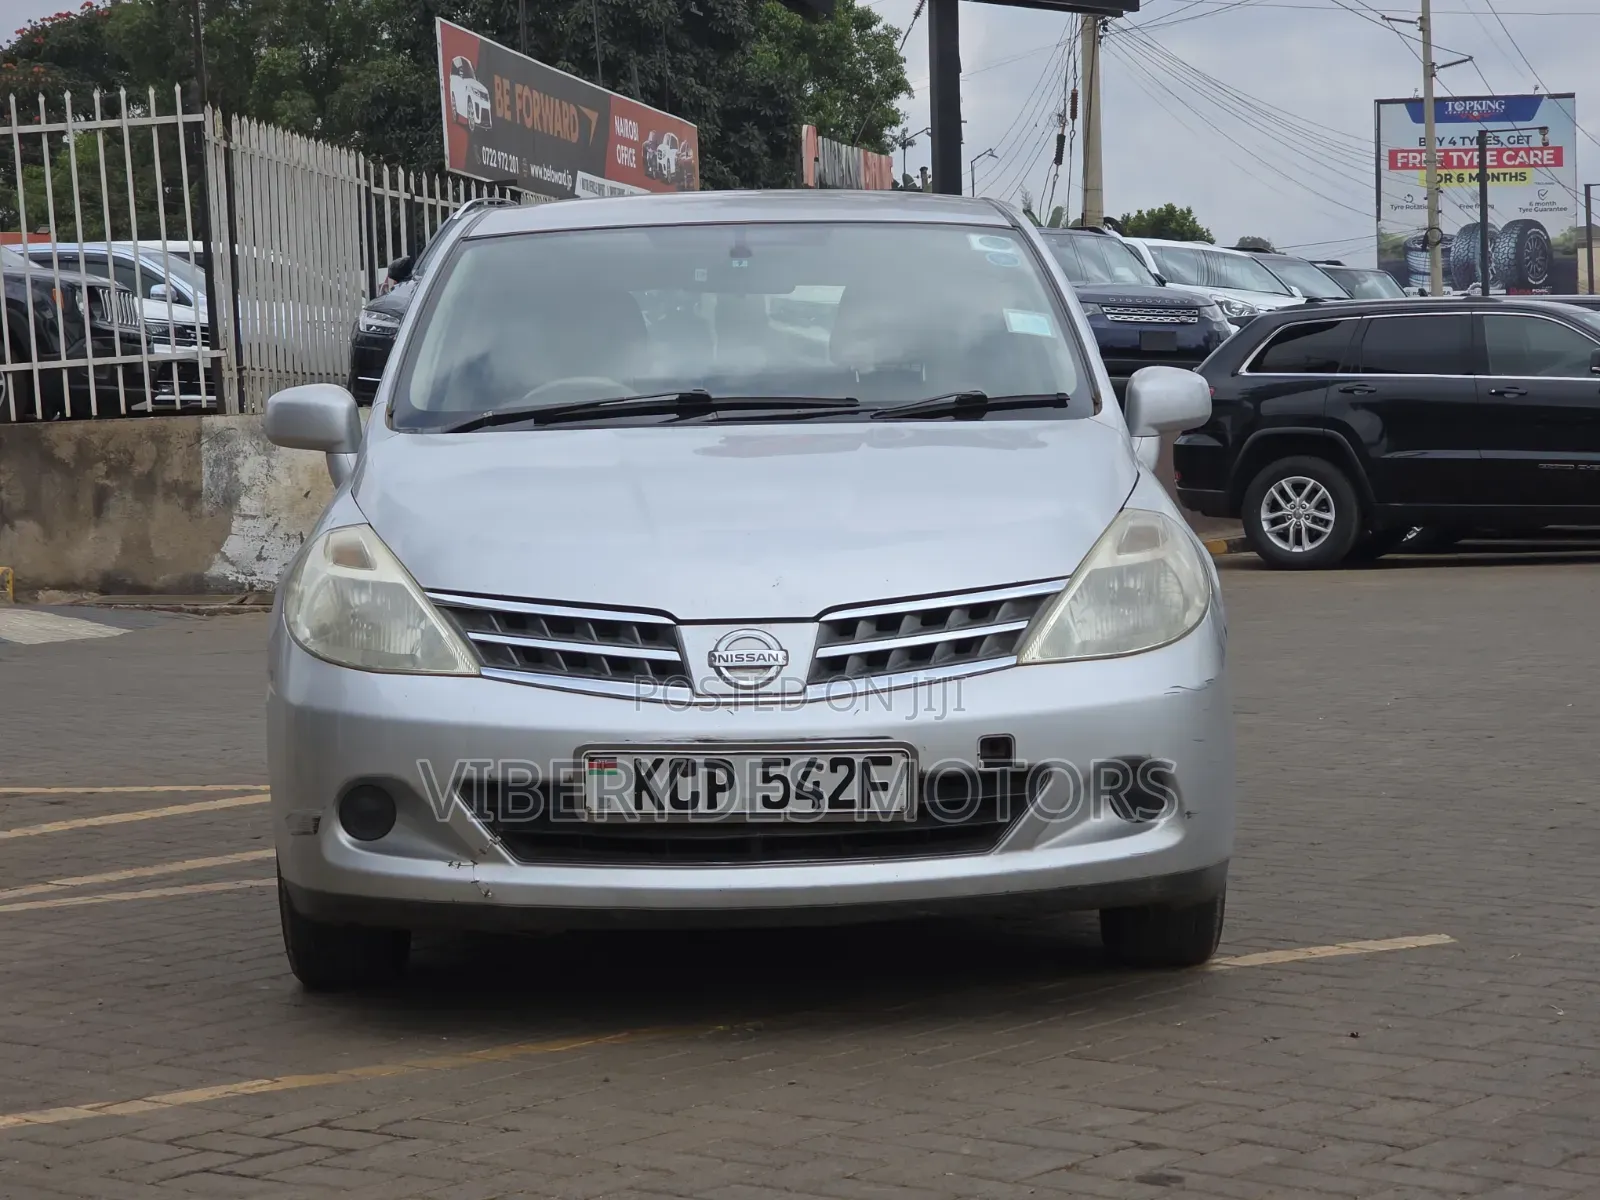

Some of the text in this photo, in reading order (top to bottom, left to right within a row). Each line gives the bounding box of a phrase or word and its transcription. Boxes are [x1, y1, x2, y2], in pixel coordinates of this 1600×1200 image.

[494, 75, 579, 143] BE FORWARD
[1445, 99, 1505, 111] TOPKING
[614, 115, 639, 141] NAIROBI
[1418, 136, 1445, 147] BY
[1448, 136, 1457, 147] 4
[1507, 134, 1532, 145] GET
[482, 145, 520, 175] 0722 972 201
[616, 144, 637, 168] OFFICE
[1502, 149, 1555, 166] CARE
[1456, 172, 1465, 184] 6
[718, 653, 779, 664] NISSAN
[632, 755, 894, 811] KCP 542F
